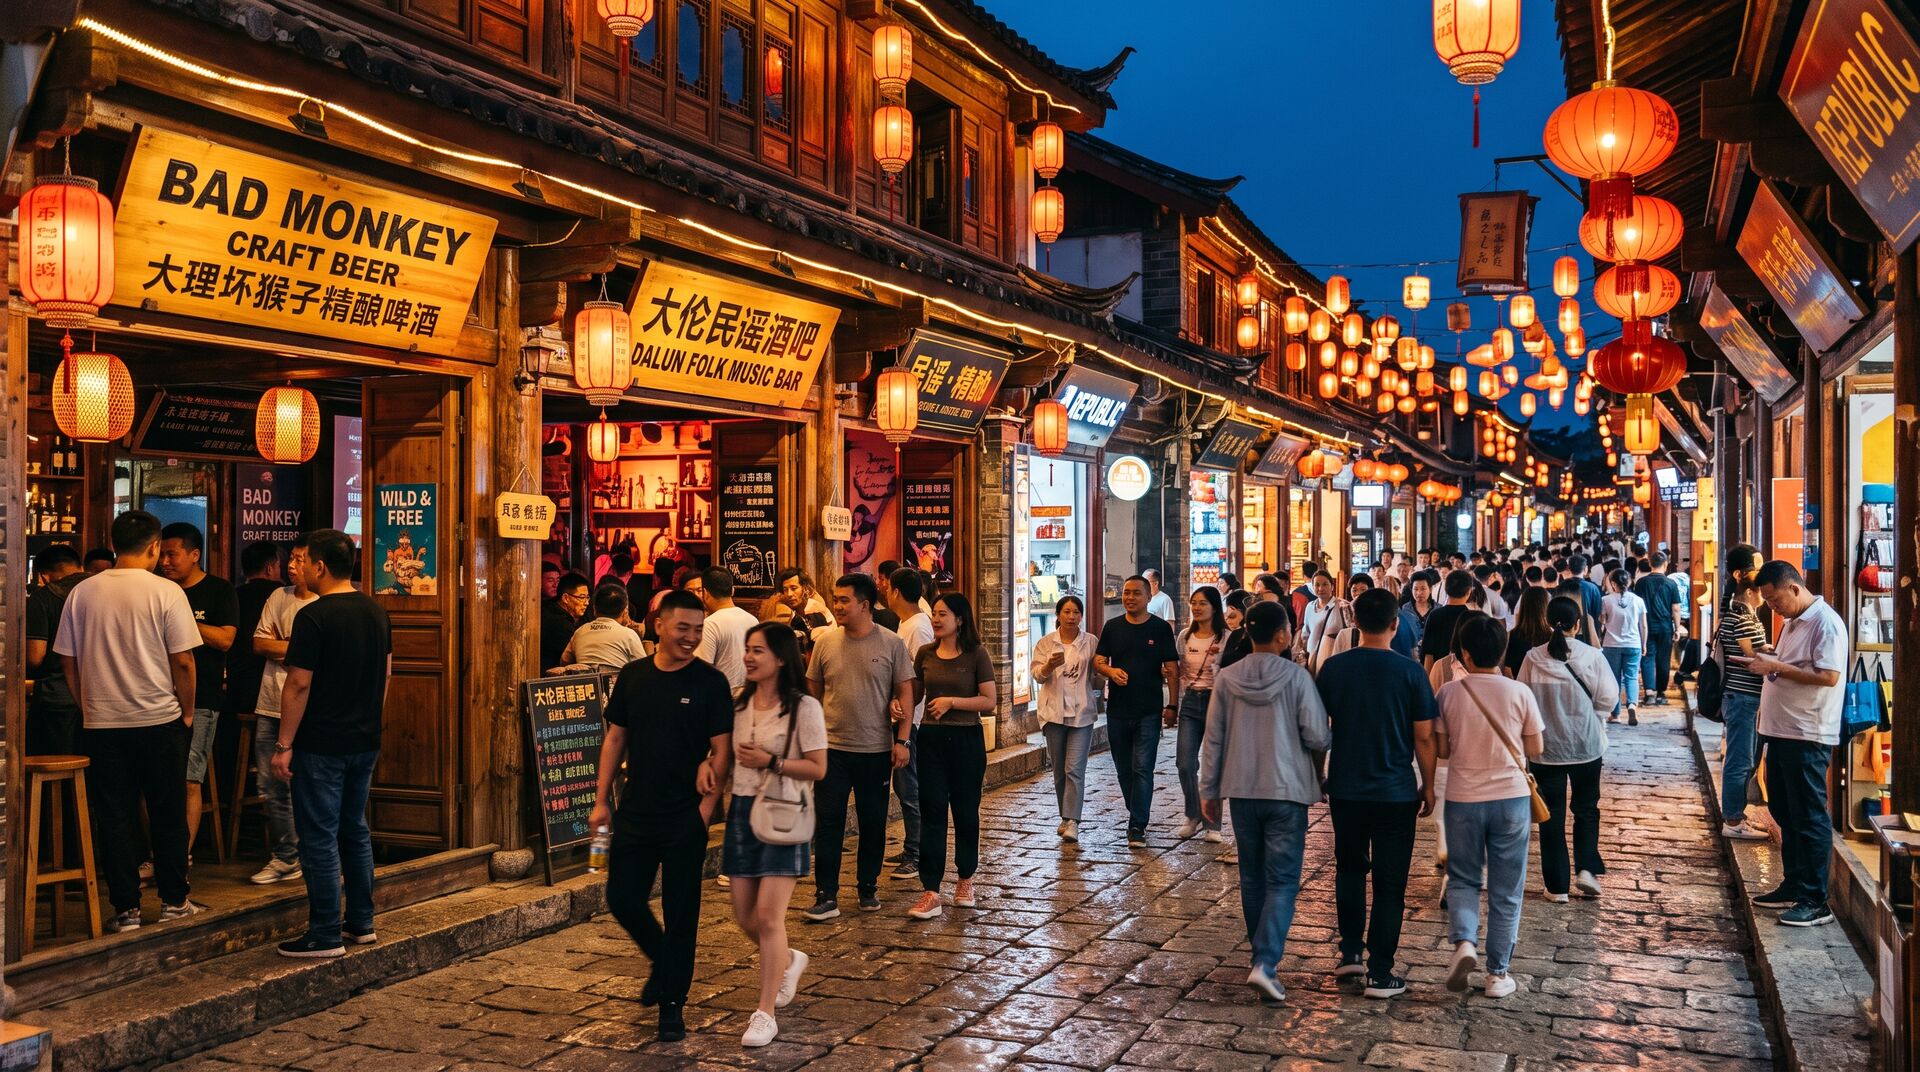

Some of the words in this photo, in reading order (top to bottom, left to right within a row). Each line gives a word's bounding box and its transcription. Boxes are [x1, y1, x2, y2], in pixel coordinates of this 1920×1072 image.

[1814, 11, 1920, 185] REPUBLIC
[158, 158, 268, 220] BAD
[280, 188, 472, 266] MONKEY
[227, 230, 325, 271] CRAFT
[329, 251, 400, 288] BEER
[142, 254, 441, 338] 大理坏猴子精酿啤酒
[642, 287, 822, 362] 大伦民谣酒吧
[632, 342, 687, 373] DALUN
[686, 353, 729, 380] FOLK
[727, 360, 775, 387] MUSIC
[773, 368, 803, 392] BAR
[1067, 391, 1127, 428] REPUBLIC
[243, 488, 272, 505] BAD
[243, 509, 301, 526] MONKEY
[380, 490, 417, 507] WILD
[420, 490, 432, 506] &
[388, 510, 424, 526] FREE
[242, 530, 270, 541] CRAFT
